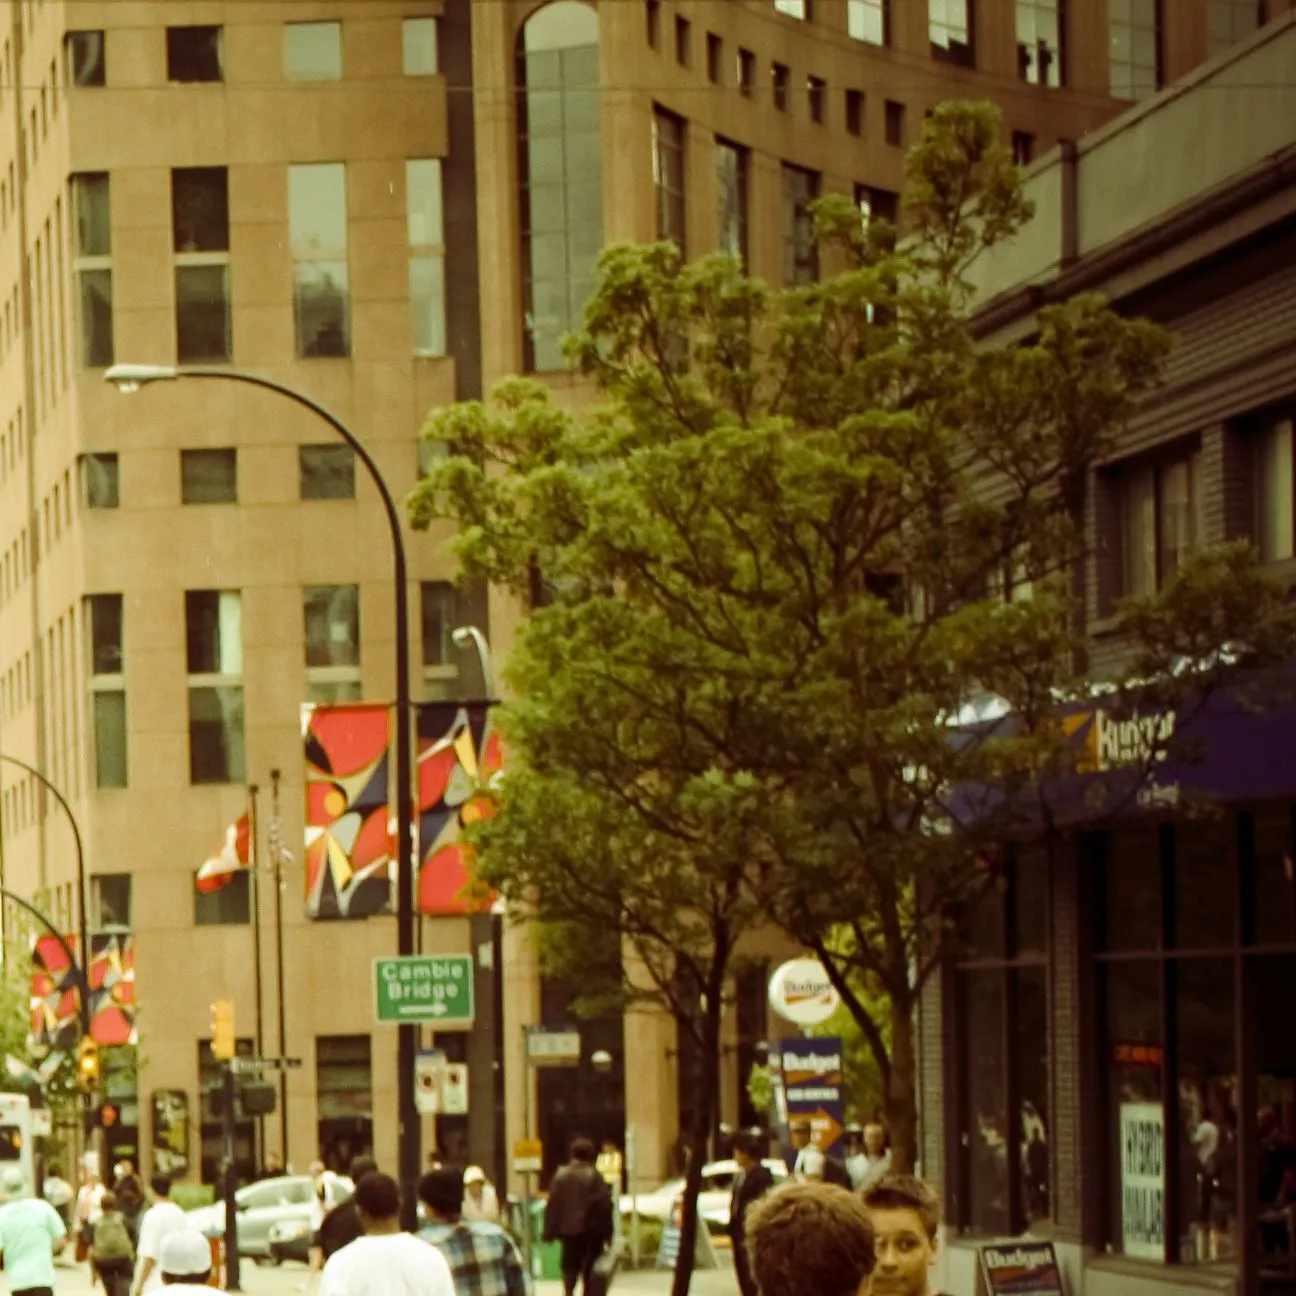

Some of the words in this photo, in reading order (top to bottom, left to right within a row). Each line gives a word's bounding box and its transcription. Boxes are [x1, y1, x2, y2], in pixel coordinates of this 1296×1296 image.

[382, 962, 463, 981] Cambie
[389, 982, 459, 1000] Bridge
[783, 1052, 841, 1076] Budget
[986, 1248, 1054, 1271] Budget
